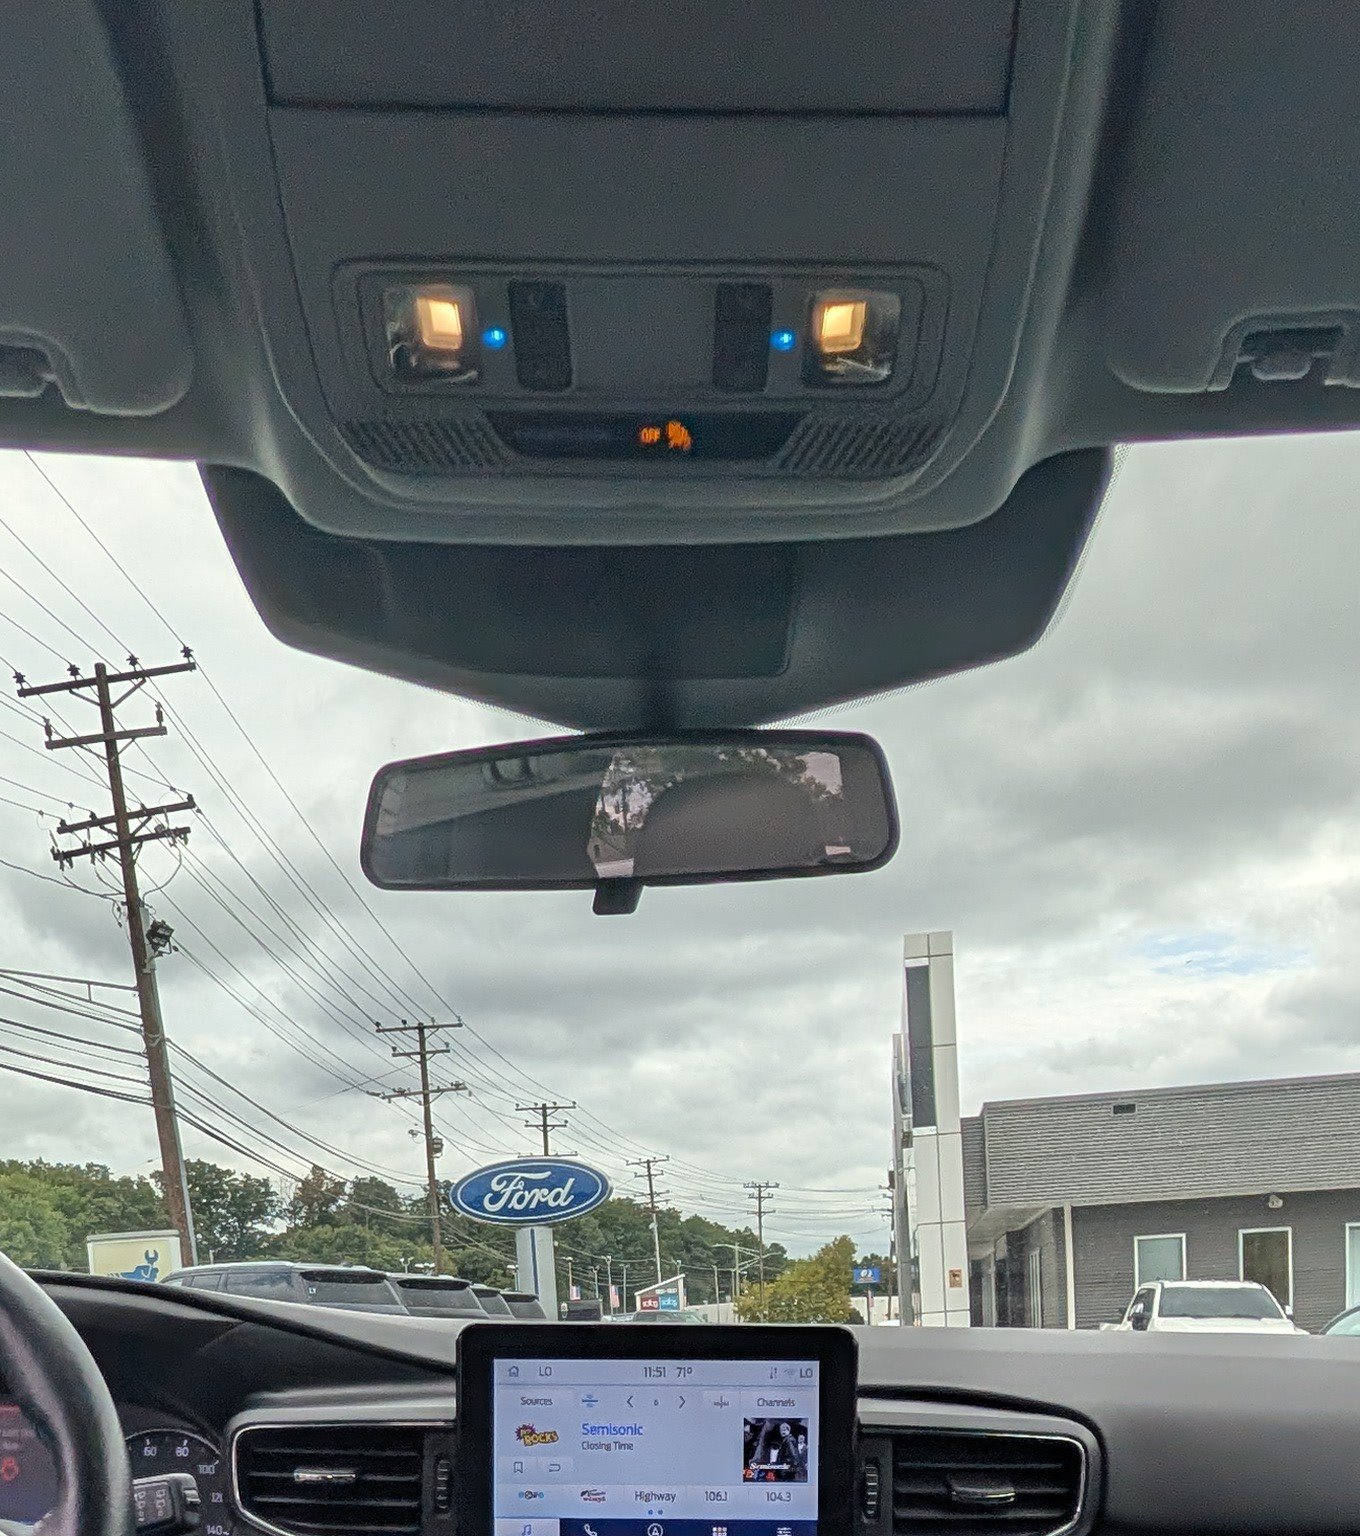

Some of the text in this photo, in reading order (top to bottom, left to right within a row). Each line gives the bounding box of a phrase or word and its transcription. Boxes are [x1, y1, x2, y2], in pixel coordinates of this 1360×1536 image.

[640, 427, 660, 443] OFF
[483, 1170, 576, 1212] Ford
[539, 1366, 553, 1377] LO
[644, 1366, 667, 1378] 11:51
[799, 1368, 814, 1379] LO
[520, 1396, 553, 1406] Sources
[757, 1397, 796, 1407] Channels
[582, 1423, 644, 1436] Semisonic
[143, 1446, 157, 1456] 60
[581, 1441, 634, 1452] Closing Time
[198, 1464, 215, 1475] 100
[634, 1490, 677, 1503] Highway
[705, 1491, 728, 1502] 106.1
[766, 1491, 792, 1502] 104.3
[206, 1525, 223, 1536] 140
